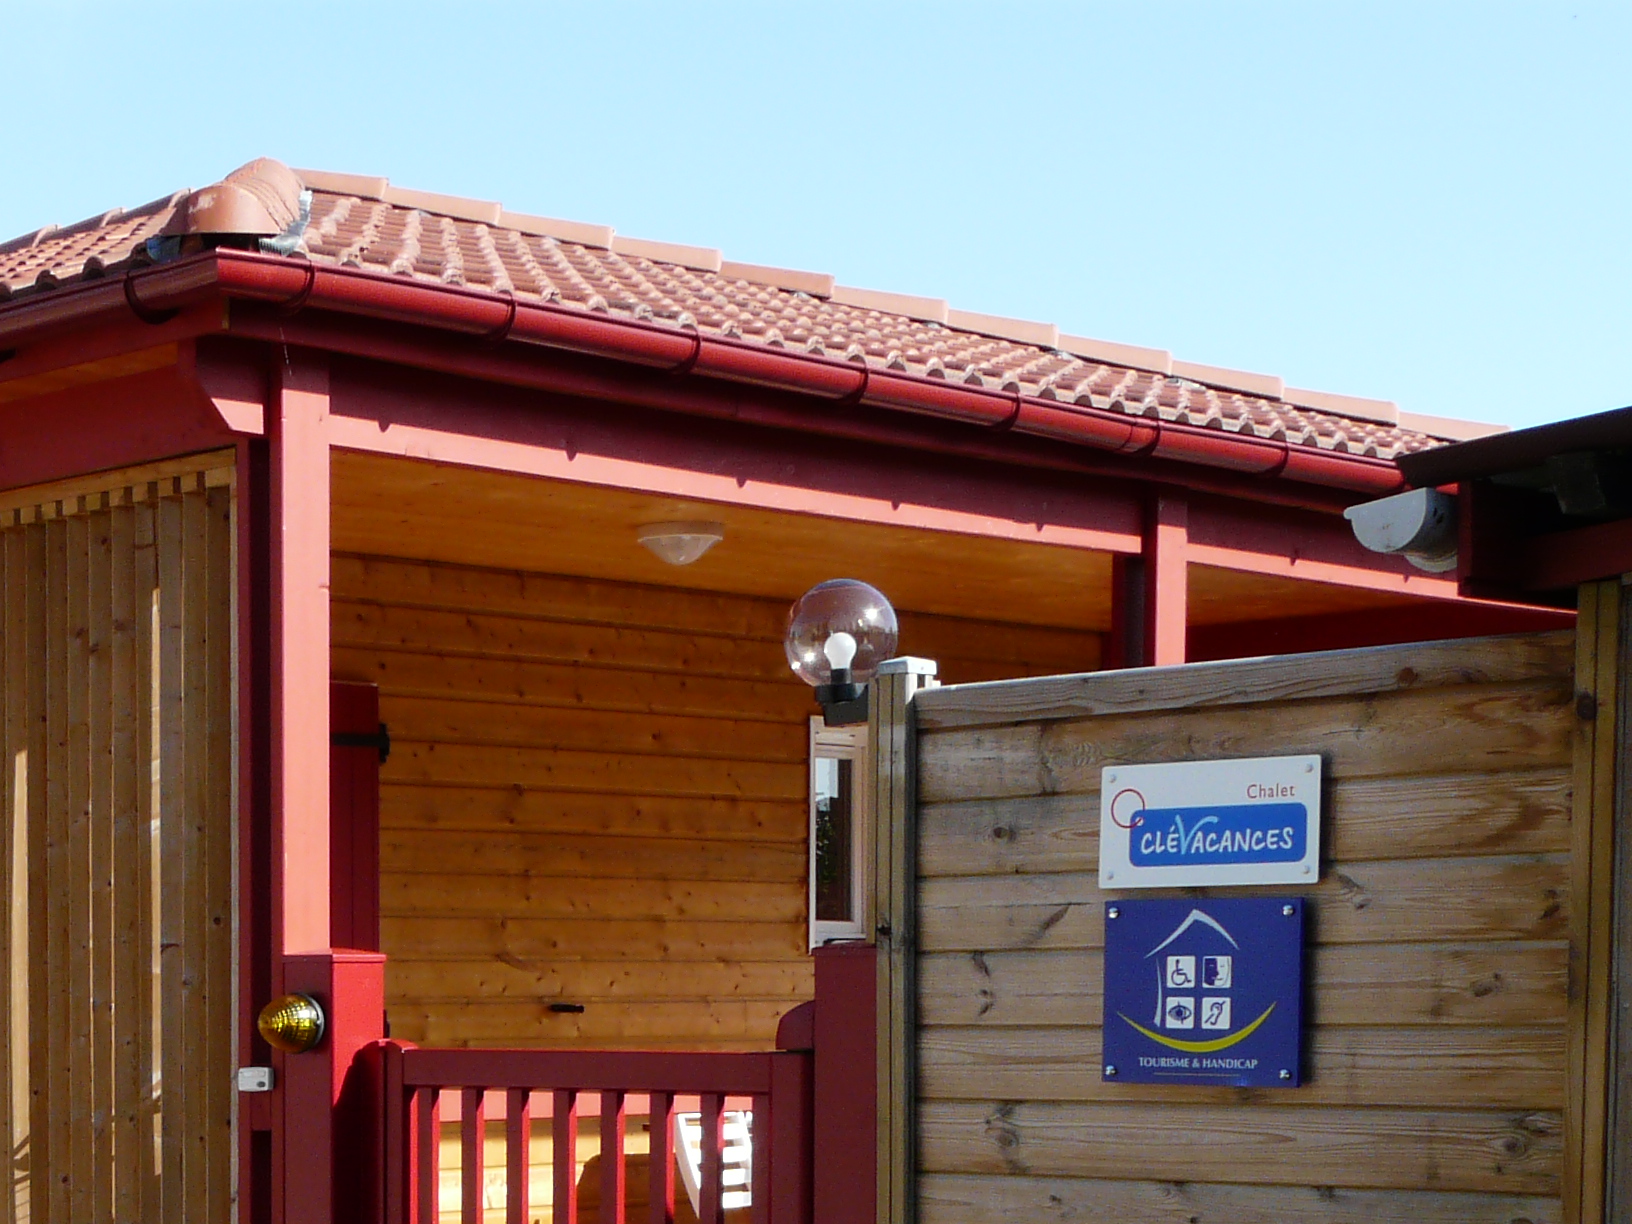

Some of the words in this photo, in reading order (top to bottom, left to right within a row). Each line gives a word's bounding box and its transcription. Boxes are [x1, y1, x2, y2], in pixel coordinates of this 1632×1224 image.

[1246, 783, 1296, 799] Chalet
[1138, 1056, 1189, 1069] TOURISME
[1191, 1057, 1200, 1069] &
[1202, 1057, 1258, 1070] HANDICAP
